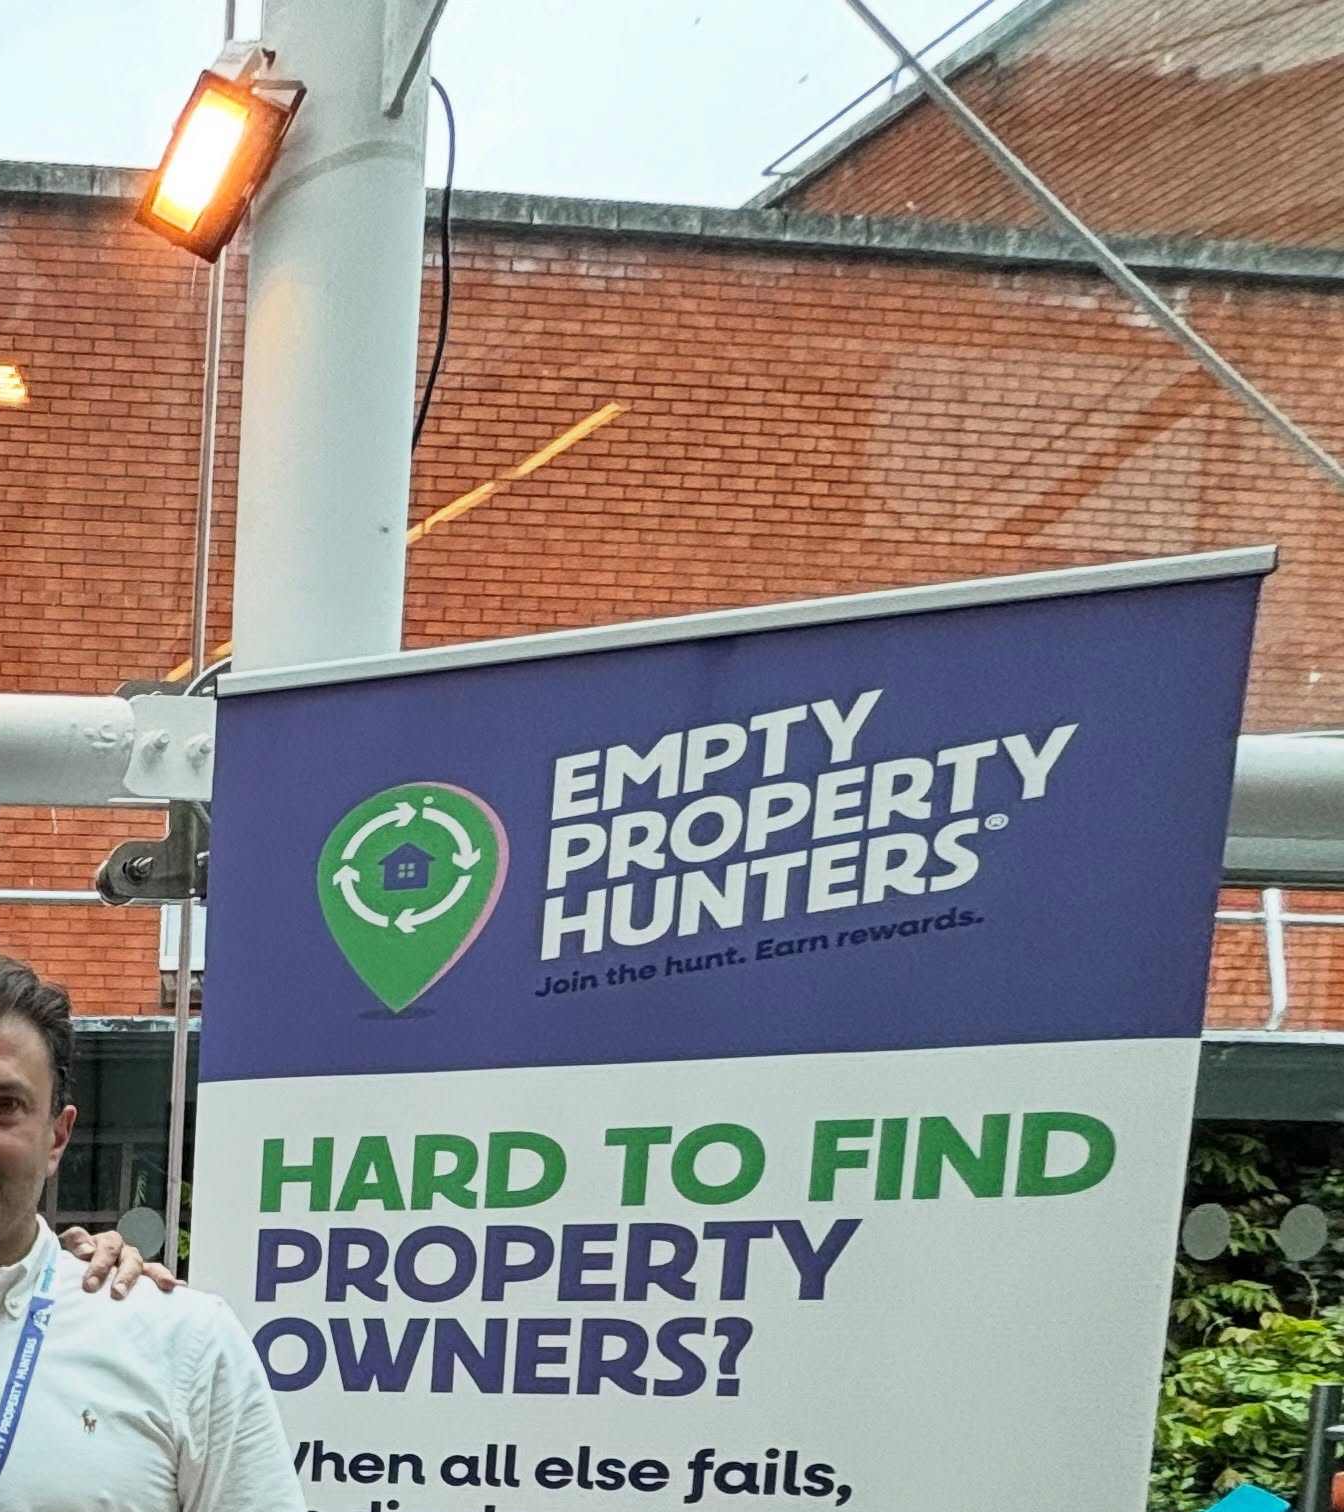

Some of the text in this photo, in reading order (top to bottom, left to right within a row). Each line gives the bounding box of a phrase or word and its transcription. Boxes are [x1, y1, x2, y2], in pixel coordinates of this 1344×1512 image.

[552, 689, 883, 820] EMPTY
[547, 724, 1078, 890] PROPERTY
[535, 907, 984, 997] Join the hunt. Earn rewards.
[260, 1112, 1116, 1212] HARD TO FIND
[255, 1219, 863, 1303] PROPERTY
[252, 1316, 754, 1396] OWNERS?
[441, 1444, 520, 1487] all
[535, 1446, 669, 1492] else
[684, 1448, 852, 1506] fails,
